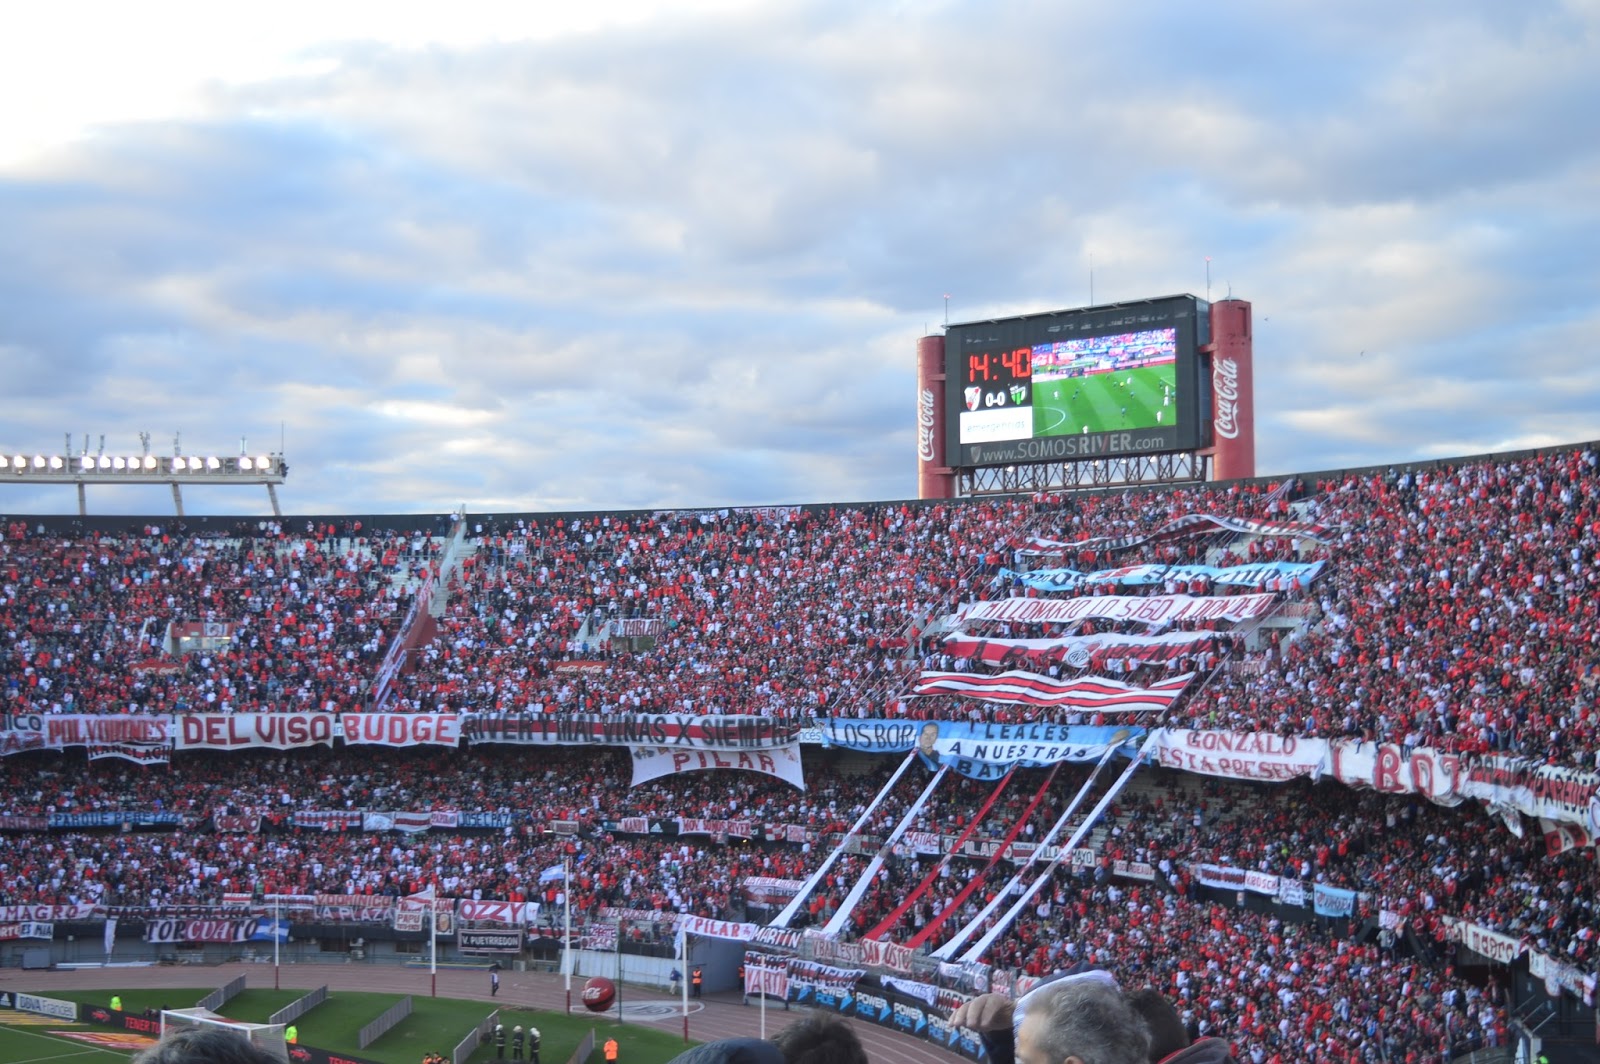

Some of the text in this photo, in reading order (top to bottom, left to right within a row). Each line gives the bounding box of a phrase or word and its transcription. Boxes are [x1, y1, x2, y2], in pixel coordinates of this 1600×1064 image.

[969, 347, 1032, 383] 14:40
[985, 391, 1006, 408] 0-0
[983, 433, 1165, 463] www.SOMOSRIVER.com
[978, 599, 1092, 620] MILLONARIO
[183, 715, 252, 745] DEL
[255, 714, 331, 746] VISO
[342, 714, 459, 744] BUDGE
[676, 715, 695, 747] X
[984, 723, 1070, 741] LEALES
[948, 741, 961, 755] A
[1186, 730, 1298, 757] GONZALO
[673, 750, 776, 773] PILAR
[5, 905, 79, 920] MAGRO
[460, 900, 523, 922] OZZY
[0, 925, 20, 938] RTE
[147, 919, 259, 942] TORCUATO
[694, 918, 741, 938] PILAR
[471, 936, 518, 946] PUEYRREDON
[856, 992, 888, 1010] POWER
[893, 1002, 924, 1021] POWER
[124, 1016, 150, 1031] TENER
[959, 1026, 983, 1045] POWE
